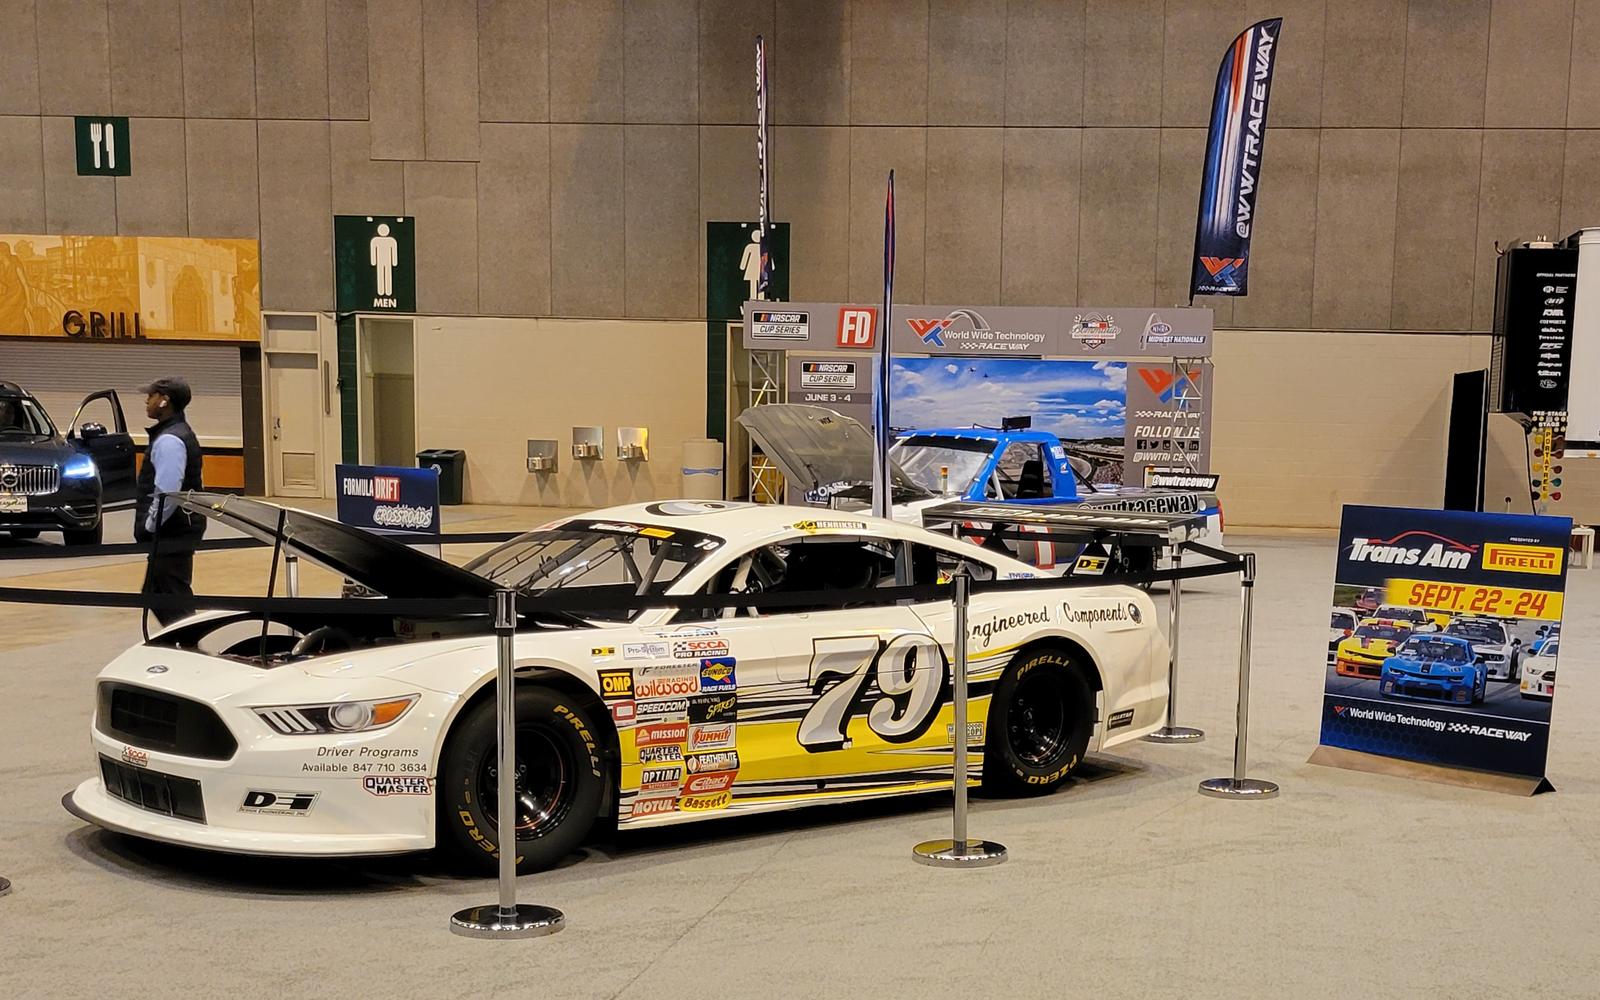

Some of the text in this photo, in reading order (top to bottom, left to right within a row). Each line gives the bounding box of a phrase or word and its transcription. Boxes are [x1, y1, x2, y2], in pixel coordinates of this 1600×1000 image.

[1236, 26, 1274, 239] @WWTRACEWAY
[373, 298, 397, 308] MEN
[63, 310, 146, 340] GRILL
[769, 315, 801, 323] NASCAR
[760, 326, 801, 334] CUP SERIES
[841, 311, 871, 344] FD
[944, 330, 1045, 342] World Wide Technology
[978, 342, 1030, 350] RACEWAY
[818, 364, 848, 372] NASCAR
[809, 375, 848, 383] CUP SERIES
[805, 393, 829, 402] JUNE
[844, 394, 851, 402] 4
[1543, 431, 1551, 492] PORTATREE
[343, 477, 399, 500] FORMULA DRIFT
[1152, 474, 1215, 489] @wwtraceway
[373, 504, 433, 528] CROSSROADS
[694, 539, 720, 551] 79
[1349, 537, 1472, 570] Trans Am
[1489, 548, 1555, 570] PIRELLI
[1408, 583, 1466, 610] SEPT.
[1469, 588, 1503, 613] 22
[1513, 592, 1549, 617] 24
[1063, 602, 1128, 628] Components
[688, 641, 727, 650] SCCA
[675, 649, 727, 658] PRO RACING
[702, 667, 732, 677] SUNOCO
[1016, 654, 1070, 681] PIRELLI
[602, 677, 632, 692] OMP
[635, 676, 698, 698] wilwood
[718, 684, 737, 692] FUELS
[797, 632, 950, 754] 79
[637, 701, 685, 714] SPEEDCOM
[1350, 706, 1532, 742] World Wide Technology RACEWAY
[553, 704, 601, 778] PIRELLI
[317, 746, 419, 759] Driver Programs
[640, 746, 680, 759] QUARTER
[646, 753, 684, 762] MASTER
[302, 763, 427, 772] Available 847 710 3634
[366, 777, 425, 788] QUARTER
[643, 768, 680, 783] OPTIMA
[376, 785, 429, 795] MASTER
[633, 799, 674, 814] MOTUL
[684, 794, 727, 810] Bassett
